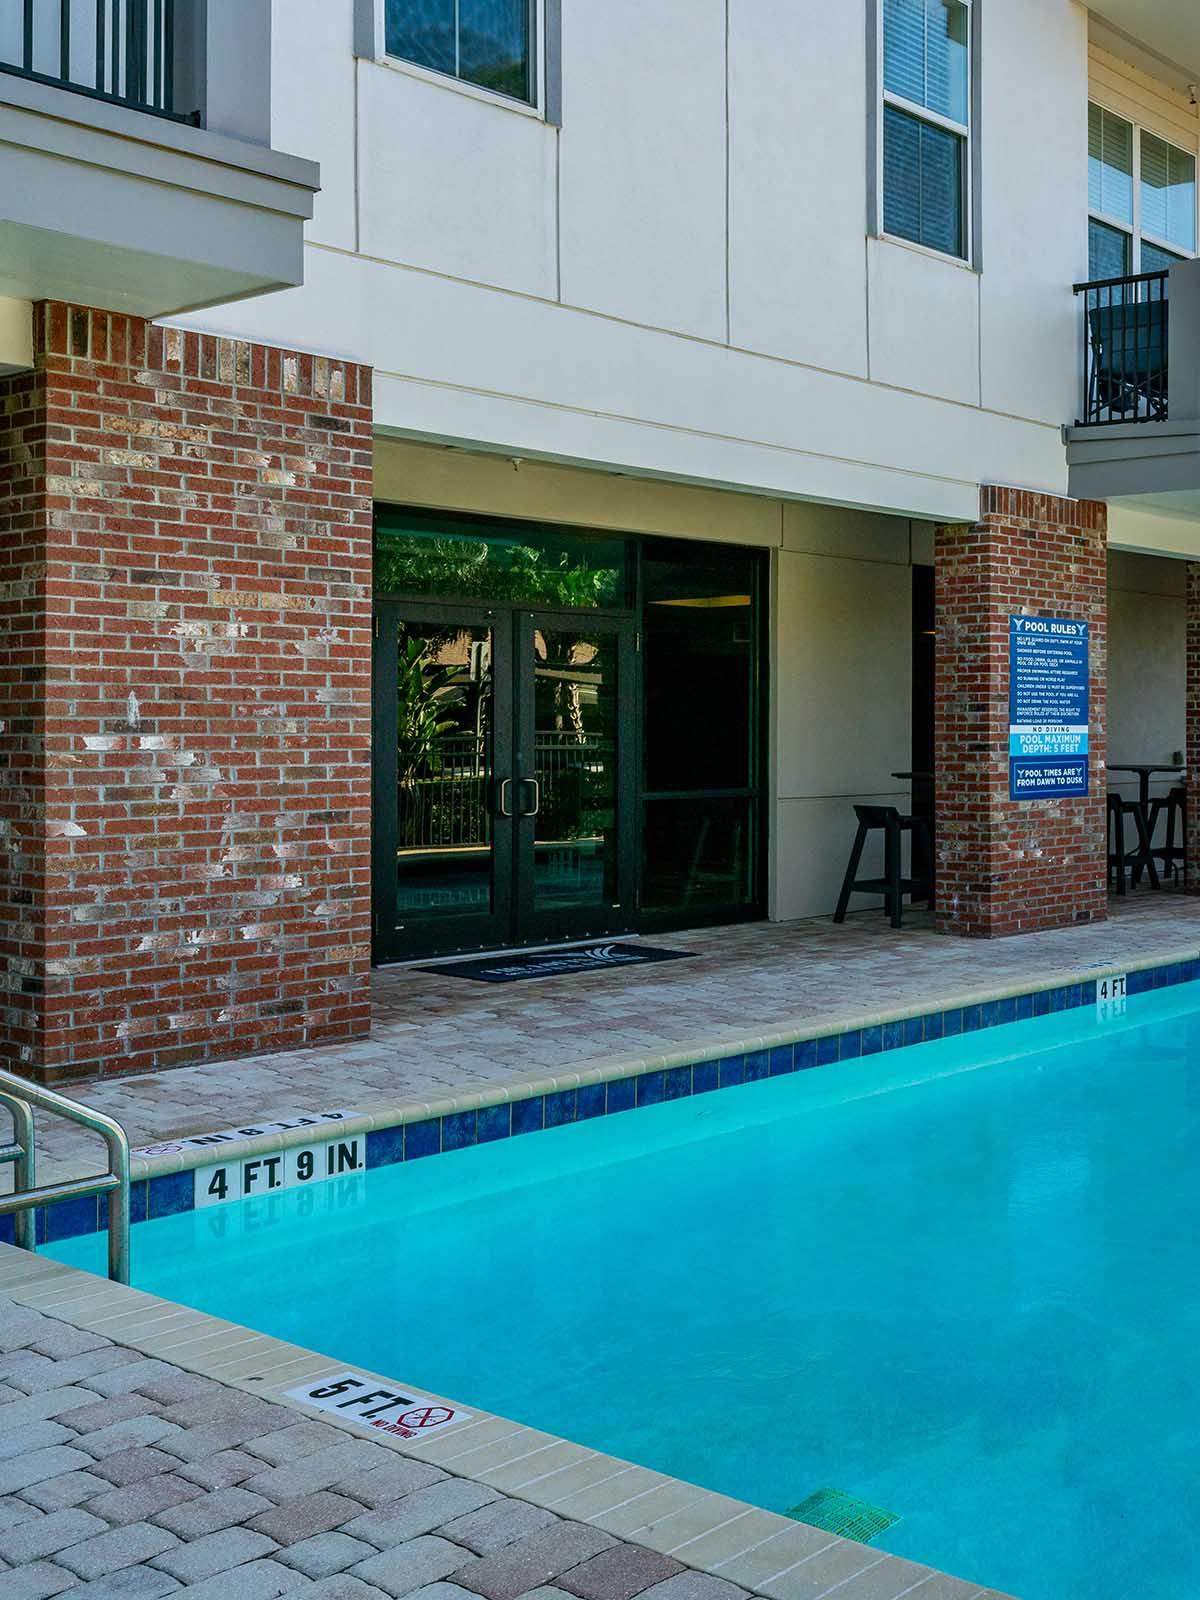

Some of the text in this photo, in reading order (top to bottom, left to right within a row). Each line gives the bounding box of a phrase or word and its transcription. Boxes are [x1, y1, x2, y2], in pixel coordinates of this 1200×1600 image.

[1025, 621, 1076, 635] POOL RULES
[1020, 734, 1080, 744] POOL MAXIMUM
[1023, 744, 1079, 753] DEPTH: 5 FEET
[1025, 768, 1076, 778] POOL TIMES ARE
[1017, 779, 1035, 787] FROM
[1036, 778, 1056, 786] DAWN
[1101, 981, 1108, 999] 4
[208, 1141, 363, 1200] 4 FT. 9 IN.
[309, 1378, 415, 1418] 5 FT.
